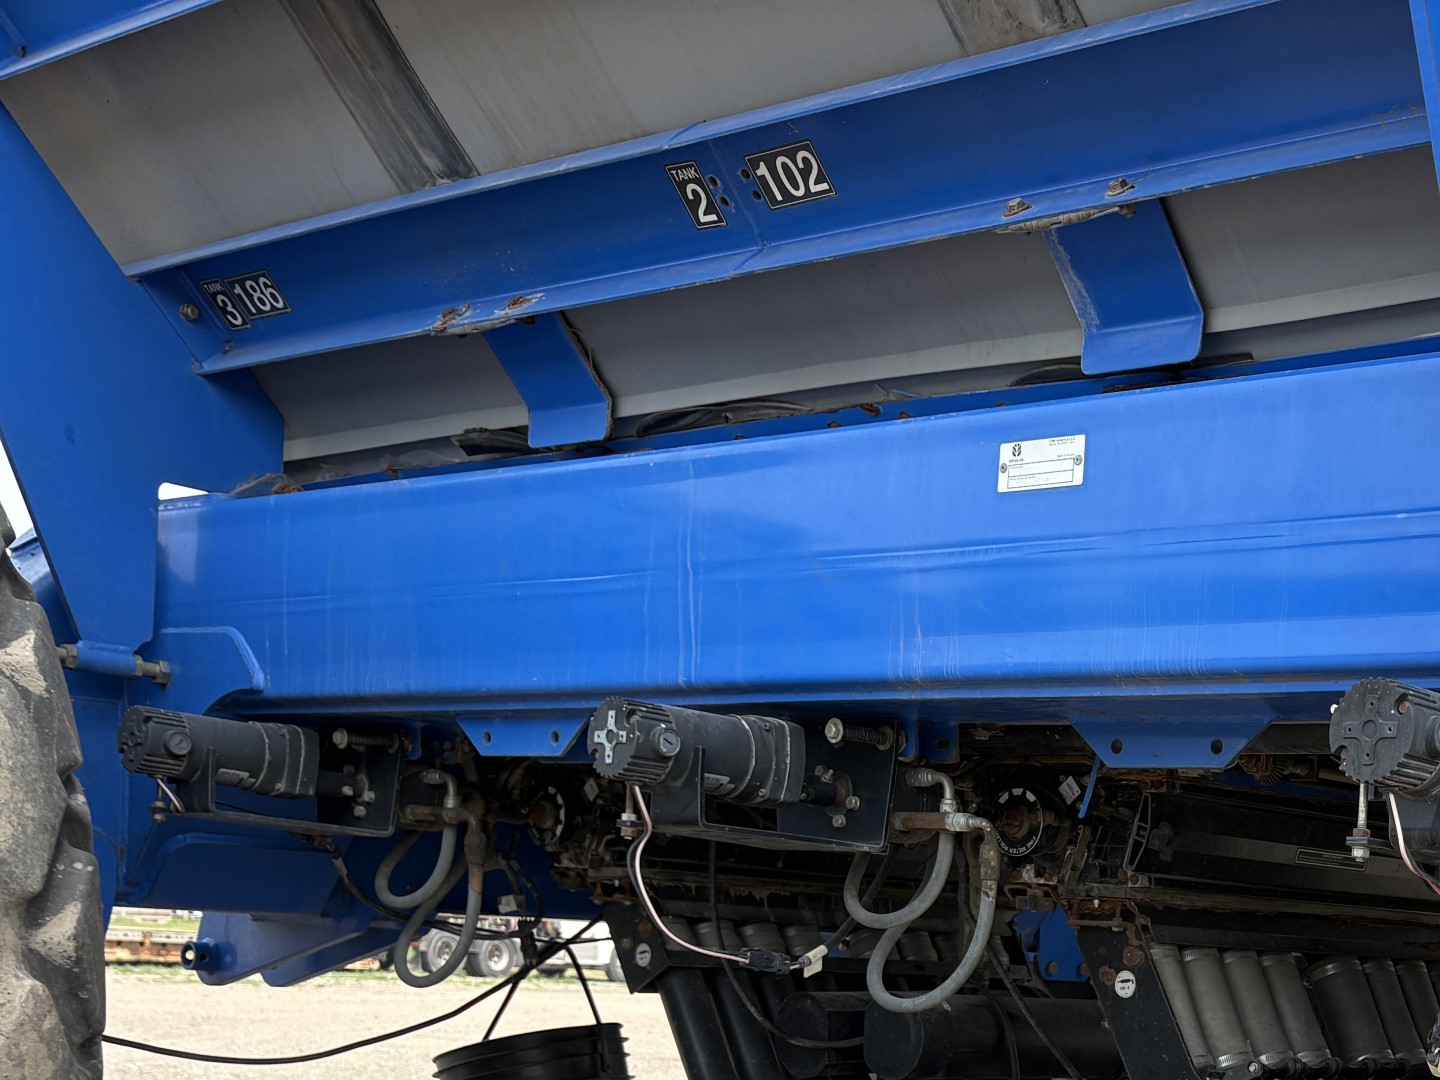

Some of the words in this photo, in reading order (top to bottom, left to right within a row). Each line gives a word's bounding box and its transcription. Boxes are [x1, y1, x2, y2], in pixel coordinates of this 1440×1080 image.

[670, 167, 700, 182] TANK
[755, 150, 830, 201] 102
[685, 183, 719, 223] 2
[203, 281, 225, 295] TANK
[233, 276, 284, 314] 186
[216, 294, 242, 326] 3
[1008, 846, 1027, 854] METER
